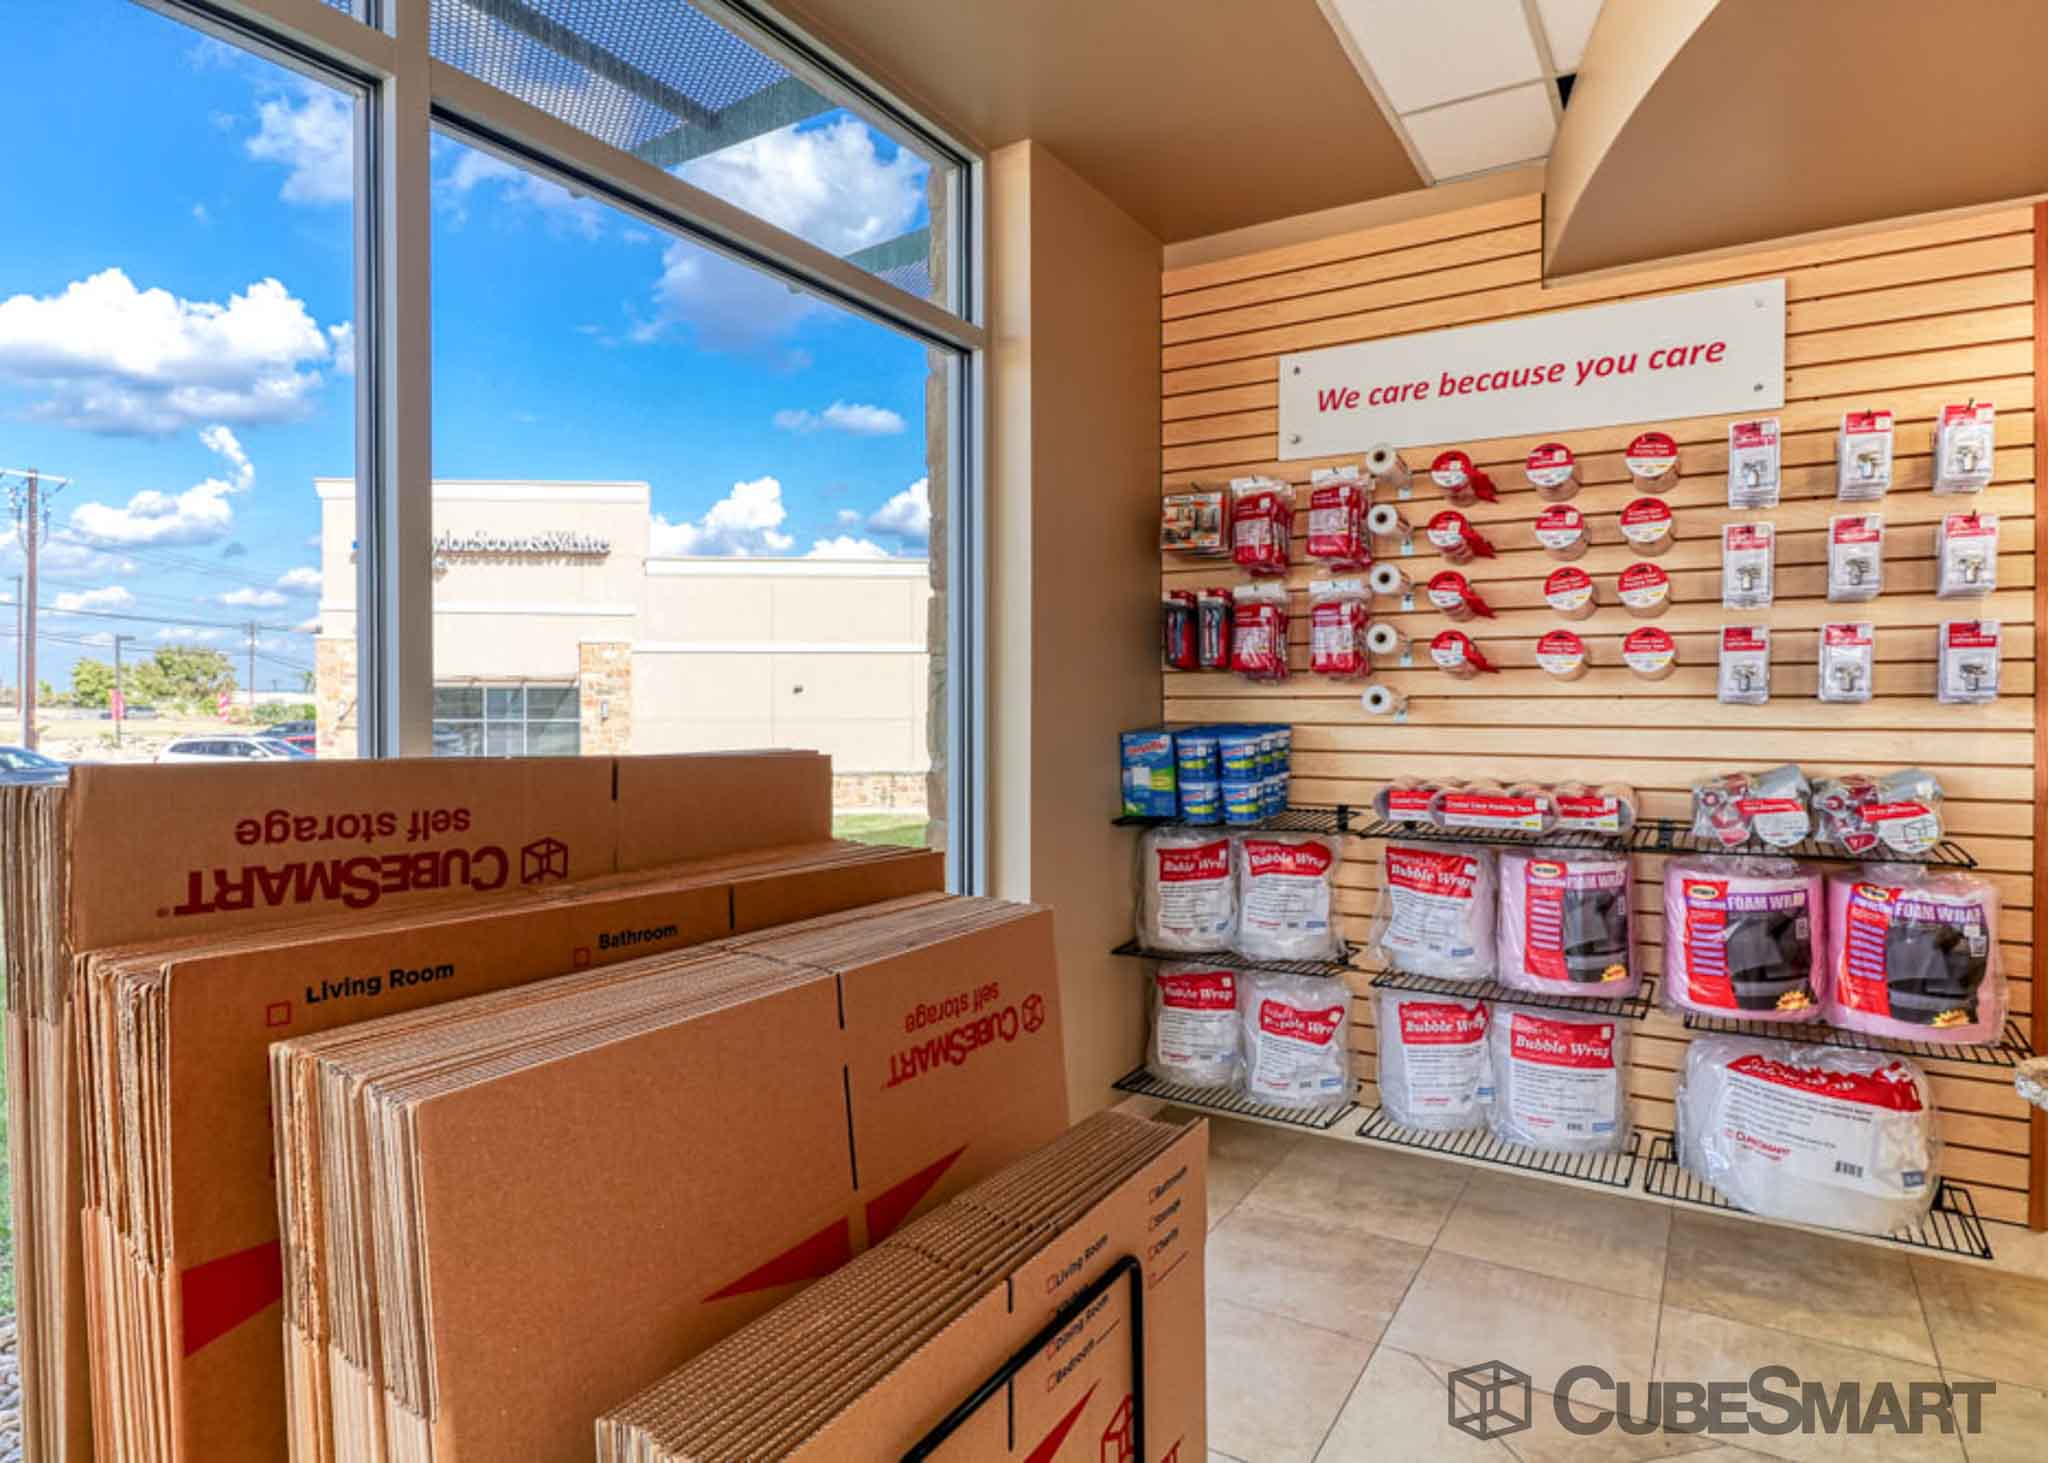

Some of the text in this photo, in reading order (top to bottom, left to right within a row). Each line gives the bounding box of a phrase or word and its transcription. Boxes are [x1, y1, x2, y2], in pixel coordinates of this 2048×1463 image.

[1315, 339, 1728, 412] We care because you care
[235, 807, 471, 845] self storage
[598, 924, 679, 950] Bathroom
[305, 962, 455, 1003] Living Room
[904, 981, 1000, 1034] self storage
[1406, 1019, 1453, 1033] Bubble
[1515, 1034, 1567, 1054] Bubble
[1056, 1256, 1084, 1288] Living
